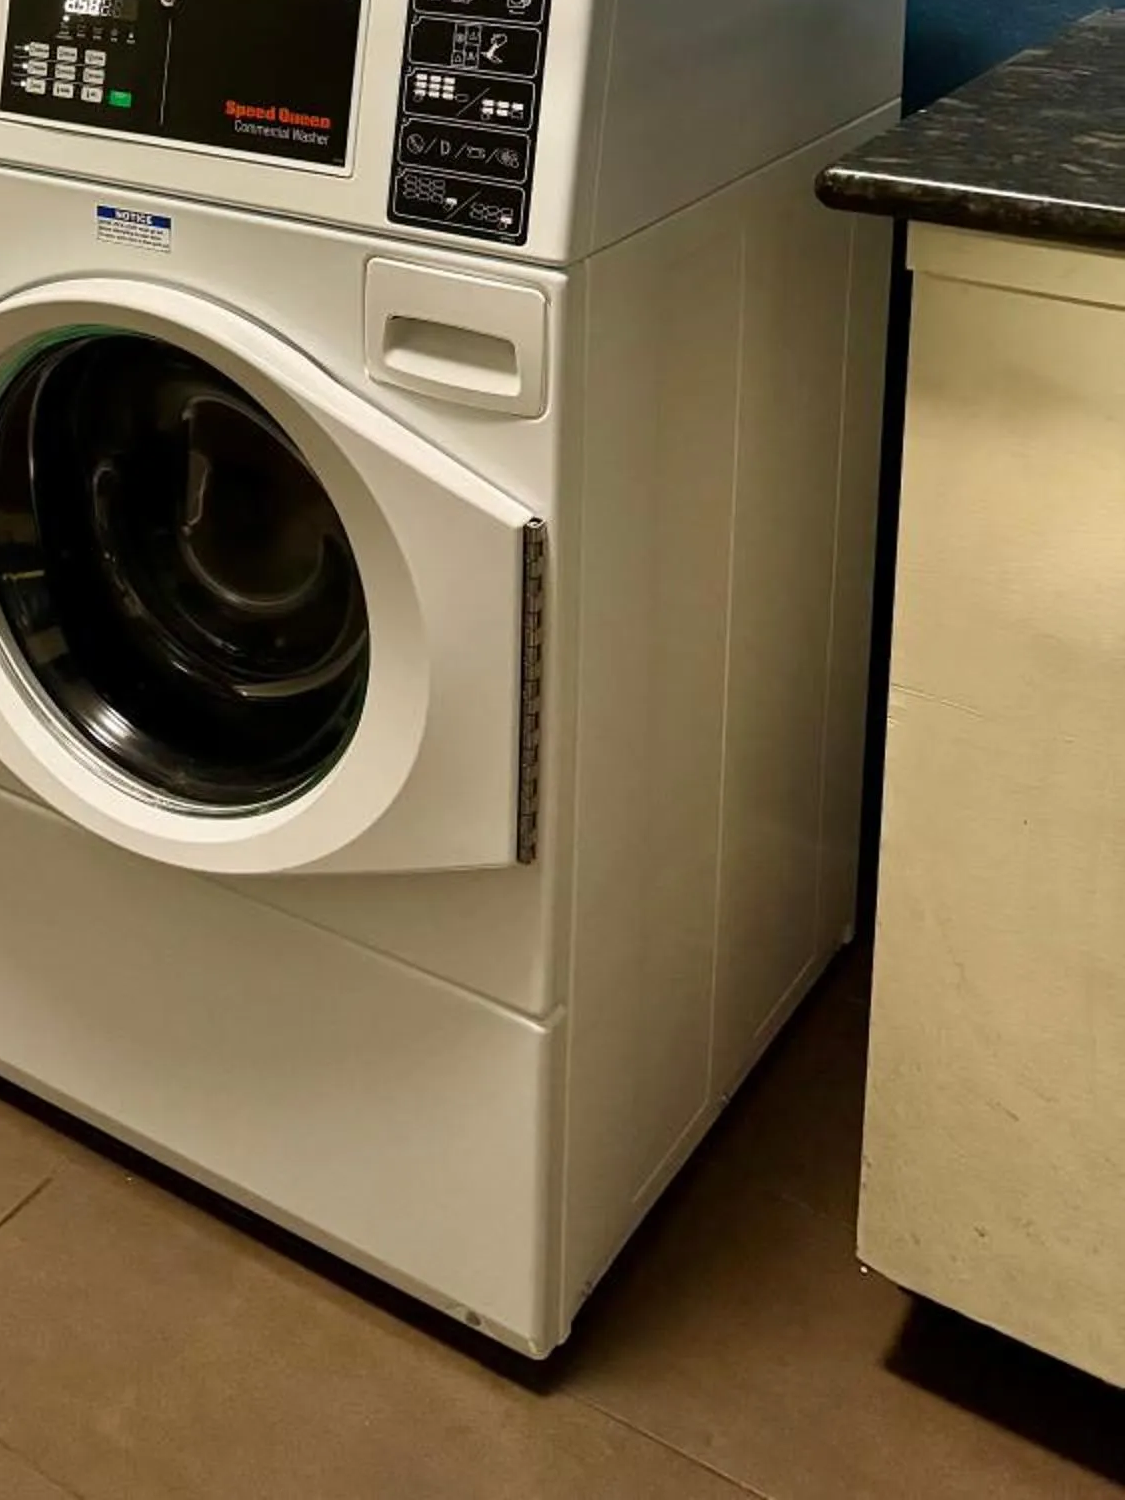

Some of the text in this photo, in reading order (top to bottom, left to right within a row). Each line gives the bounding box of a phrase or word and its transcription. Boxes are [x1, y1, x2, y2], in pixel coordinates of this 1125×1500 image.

[225, 100, 332, 129] Speed Queen
[235, 120, 330, 145] Commercial Washer
